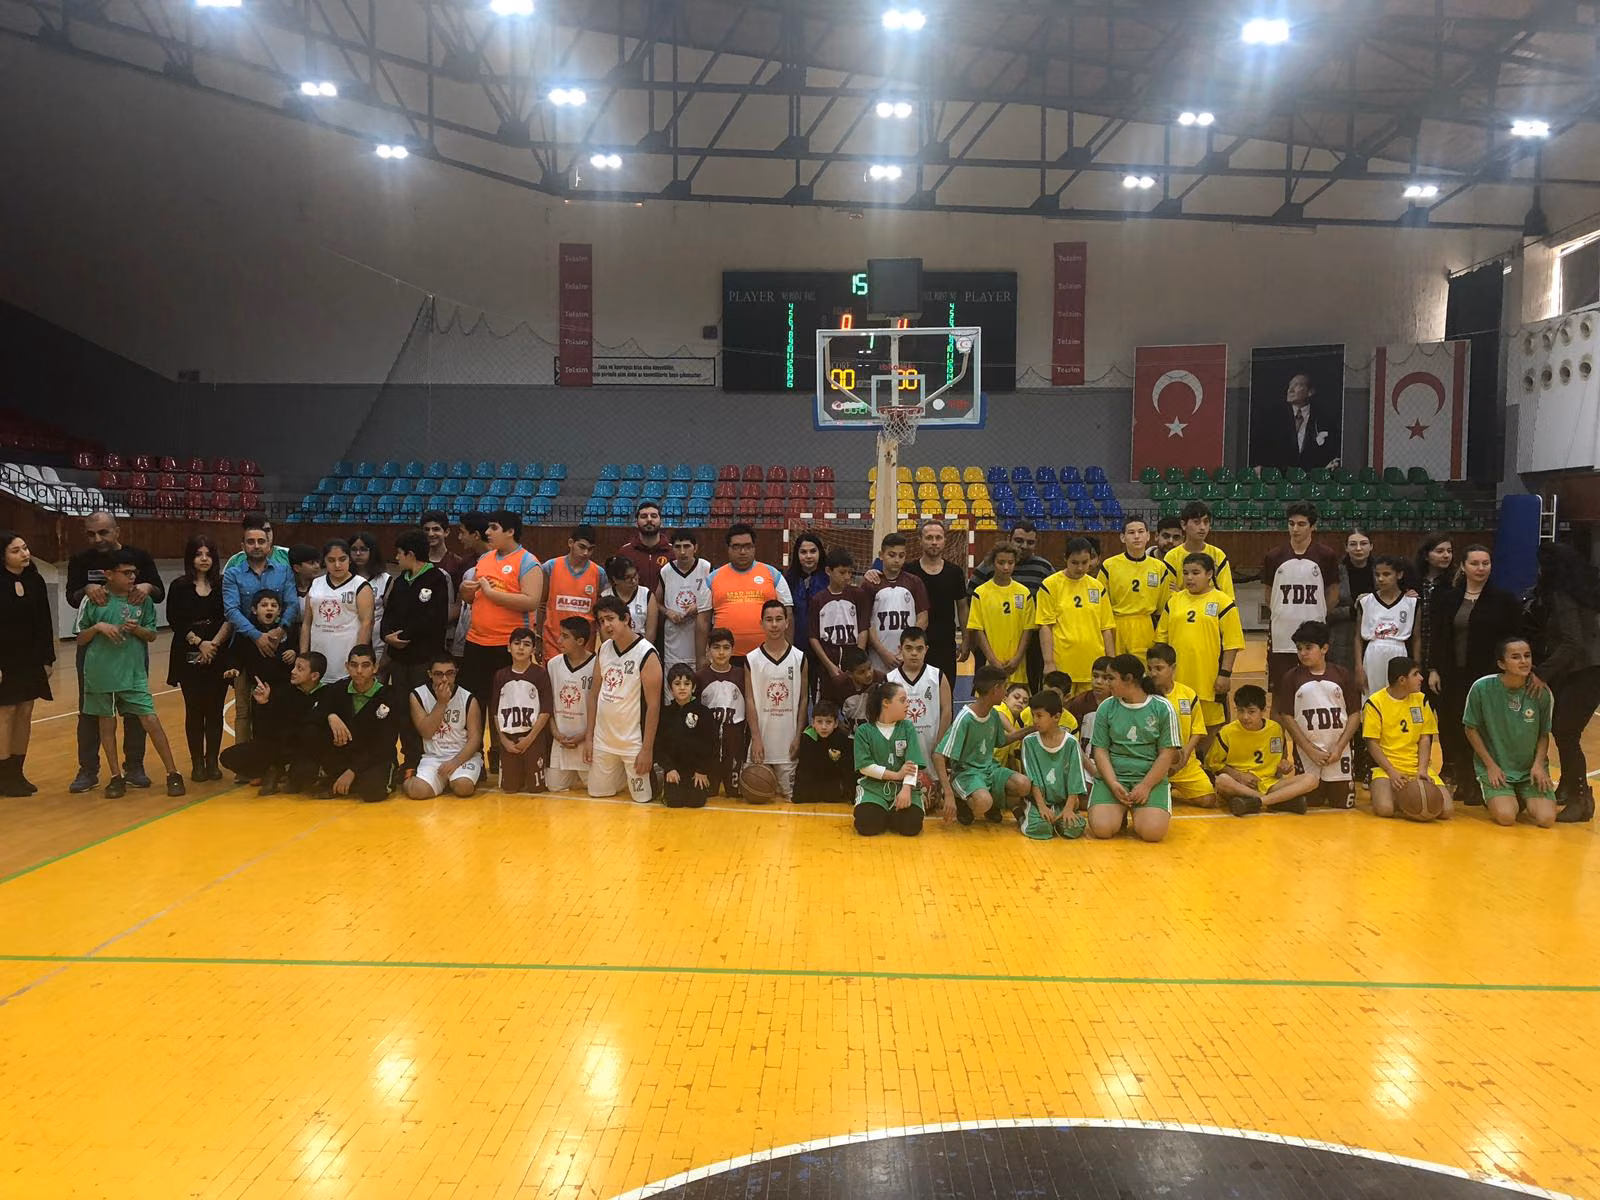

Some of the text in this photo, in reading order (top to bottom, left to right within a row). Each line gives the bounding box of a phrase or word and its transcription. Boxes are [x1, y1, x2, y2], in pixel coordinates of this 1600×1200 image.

[852, 273, 868, 295] 15
[729, 290, 776, 302] PLAYER
[965, 291, 1012, 303] PLAYER
[830, 369, 855, 390] 00
[695, 579, 702, 591] 7
[1132, 579, 1140, 592] 2
[341, 591, 354, 604] 10
[1073, 596, 1081, 608] 2
[1279, 586, 1317, 604] YDK
[1003, 602, 1011, 614] 2
[877, 611, 910, 631] YDK
[1187, 611, 1195, 622] 2
[1400, 611, 1407, 623] 9
[824, 625, 856, 644] YDK
[623, 660, 635, 675] 12
[581, 675, 593, 690] 11
[444, 709, 461, 723] 13
[501, 706, 534, 728] YDK
[1302, 708, 1344, 730] YDK
[1400, 720, 1408, 732] 2
[1126, 726, 1136, 742] 4
[979, 738, 987, 755] 4
[888, 753, 895, 766] 4
[1253, 751, 1263, 764] 2
[1341, 757, 1350, 774] 6
[1046, 768, 1056, 784] 4
[630, 777, 644, 792] 12
[1346, 793, 1355, 808] 6
